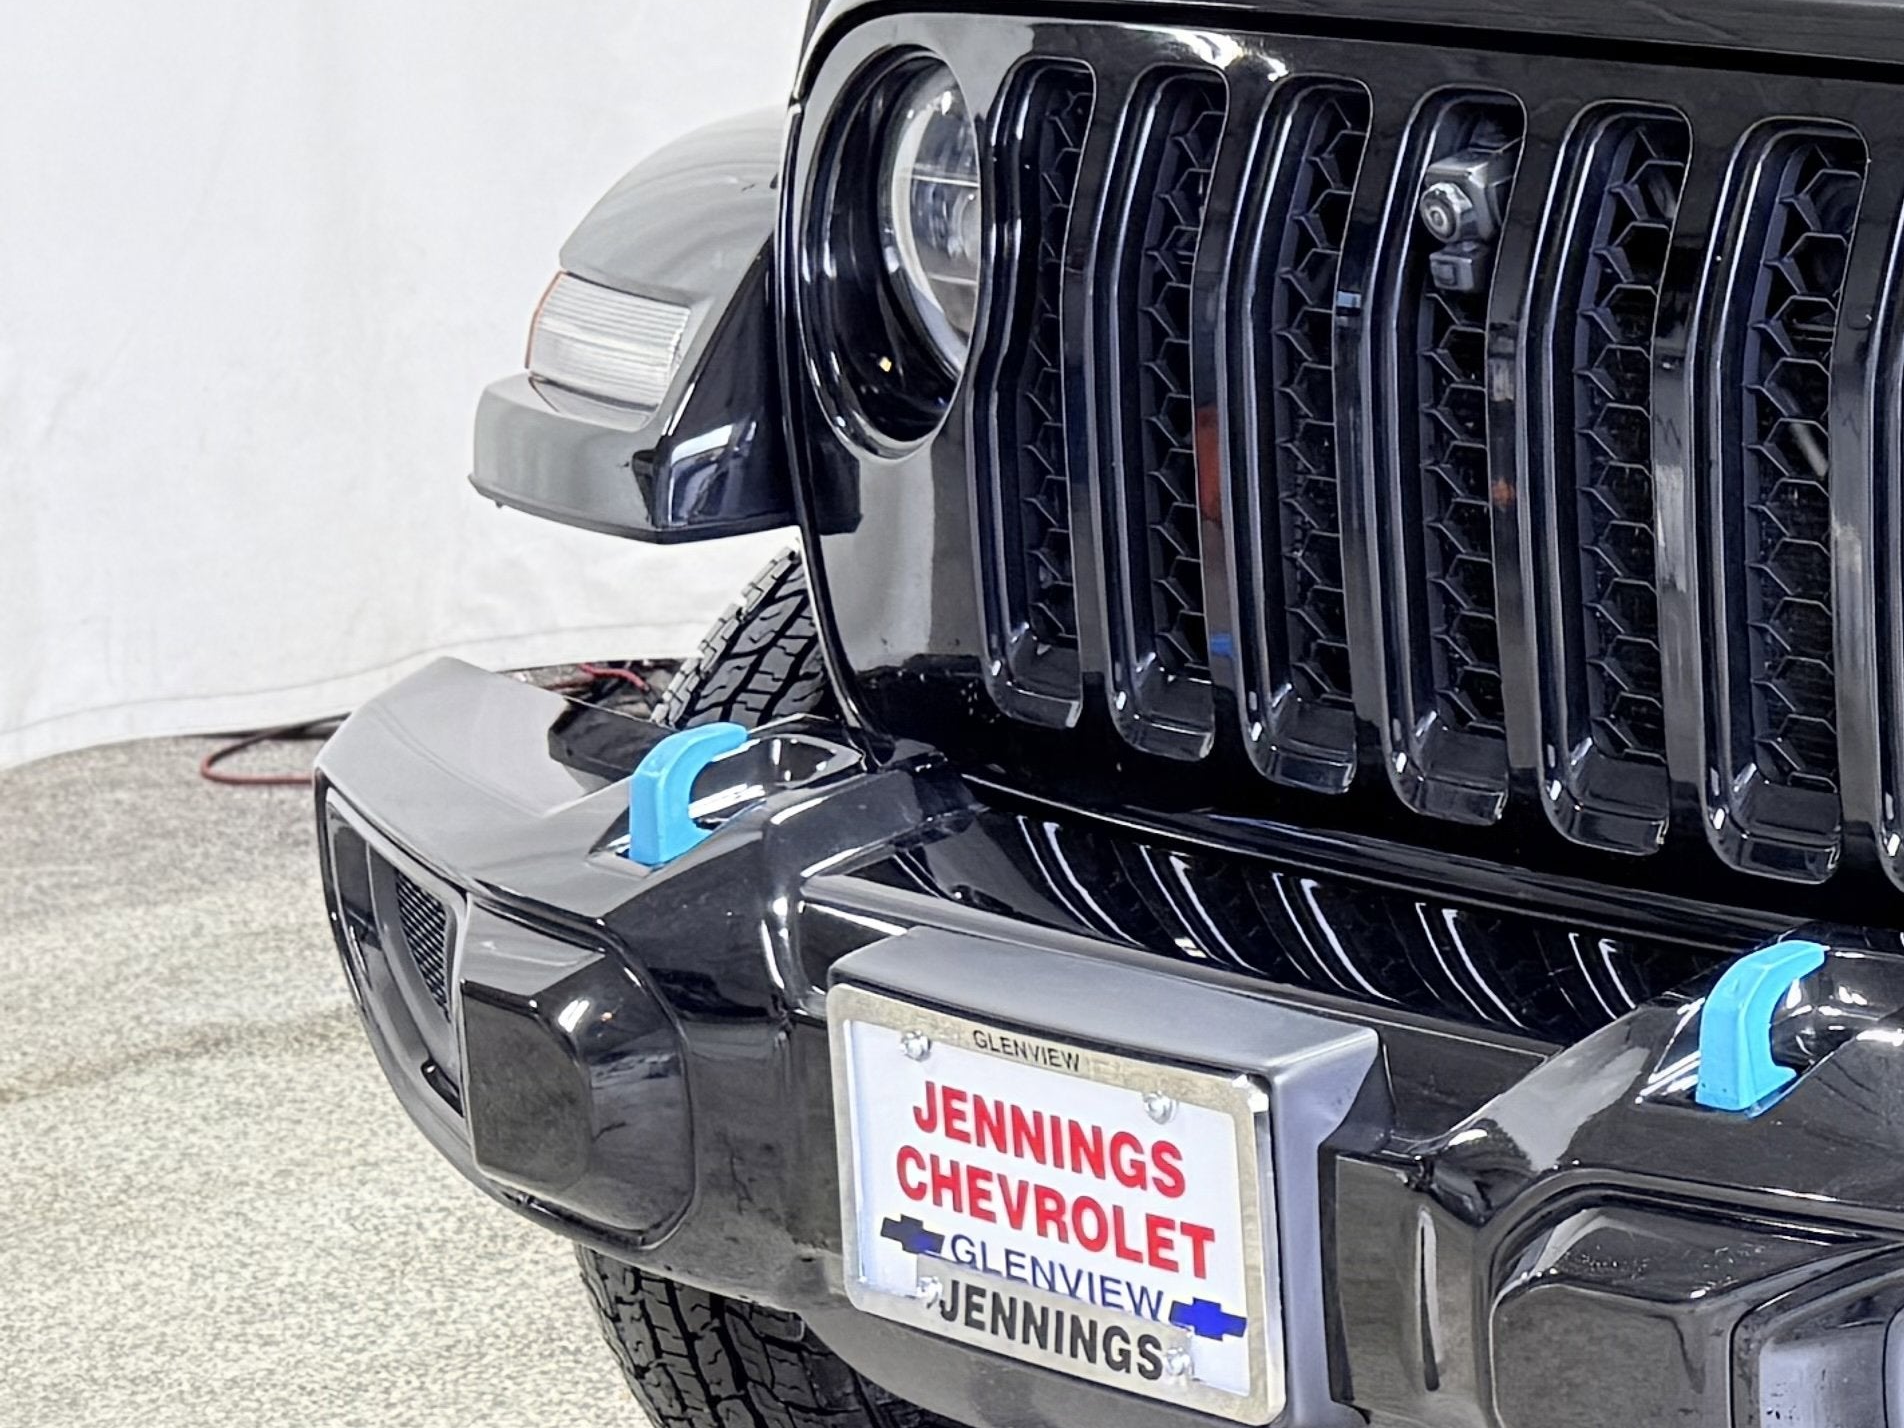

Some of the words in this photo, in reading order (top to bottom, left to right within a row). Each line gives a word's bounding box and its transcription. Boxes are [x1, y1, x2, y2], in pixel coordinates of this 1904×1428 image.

[972, 1029, 1080, 1072] GLENVIEW
[913, 1081, 1186, 1199] JENNINGS
[896, 1145, 1215, 1279] CHEVROLET
[950, 1234, 1164, 1322] GLENVIEW
[939, 1279, 1164, 1381] JENNINGS
